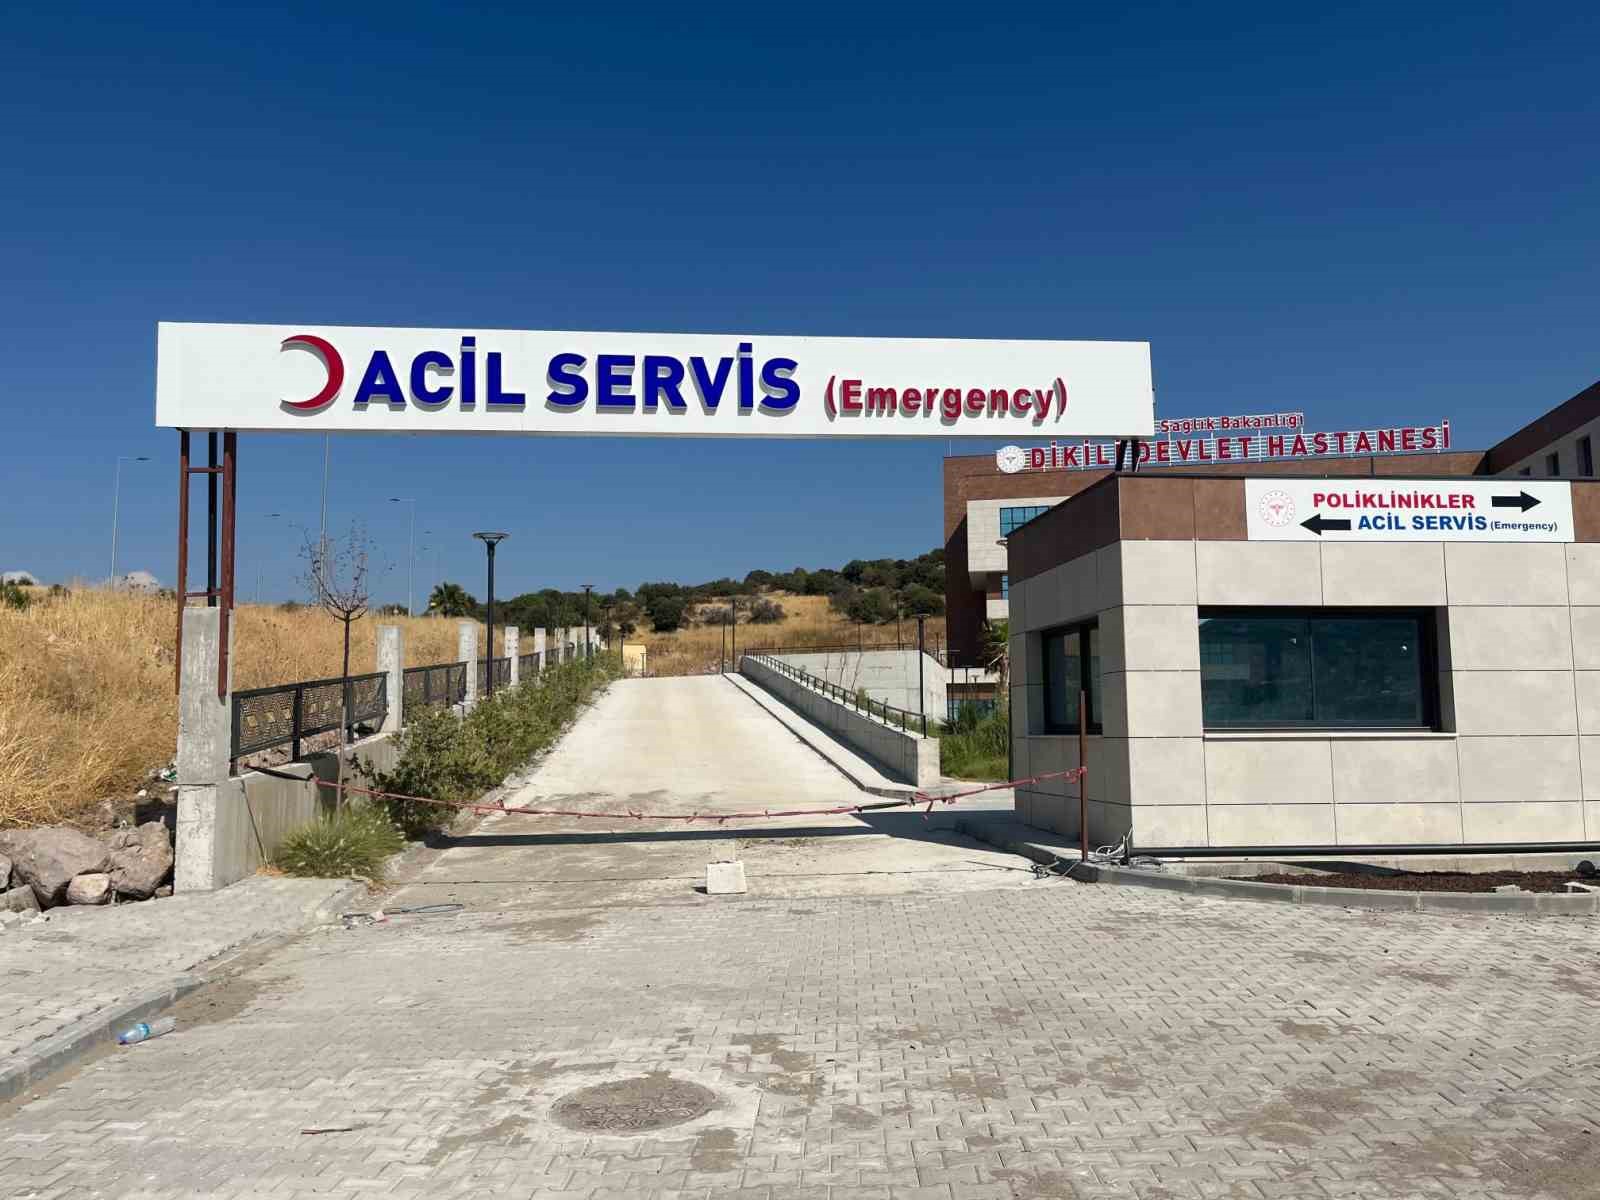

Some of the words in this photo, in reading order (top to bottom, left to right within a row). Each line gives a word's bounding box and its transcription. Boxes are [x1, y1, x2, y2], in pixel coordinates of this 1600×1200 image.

[354, 336, 527, 407] ACİL
[547, 342, 801, 412] SERVİS
[825, 375, 1067, 421] (Emergency)
[1136, 437, 1252, 463] DEVLET
[1267, 418, 1450, 456] HASTANESİ
[1312, 490, 1477, 509] POLİKLİNİKLER
[1358, 512, 1406, 530] ACİL
[1411, 512, 1487, 531] SERVİS
[1490, 521, 1558, 533] (Emergency)
